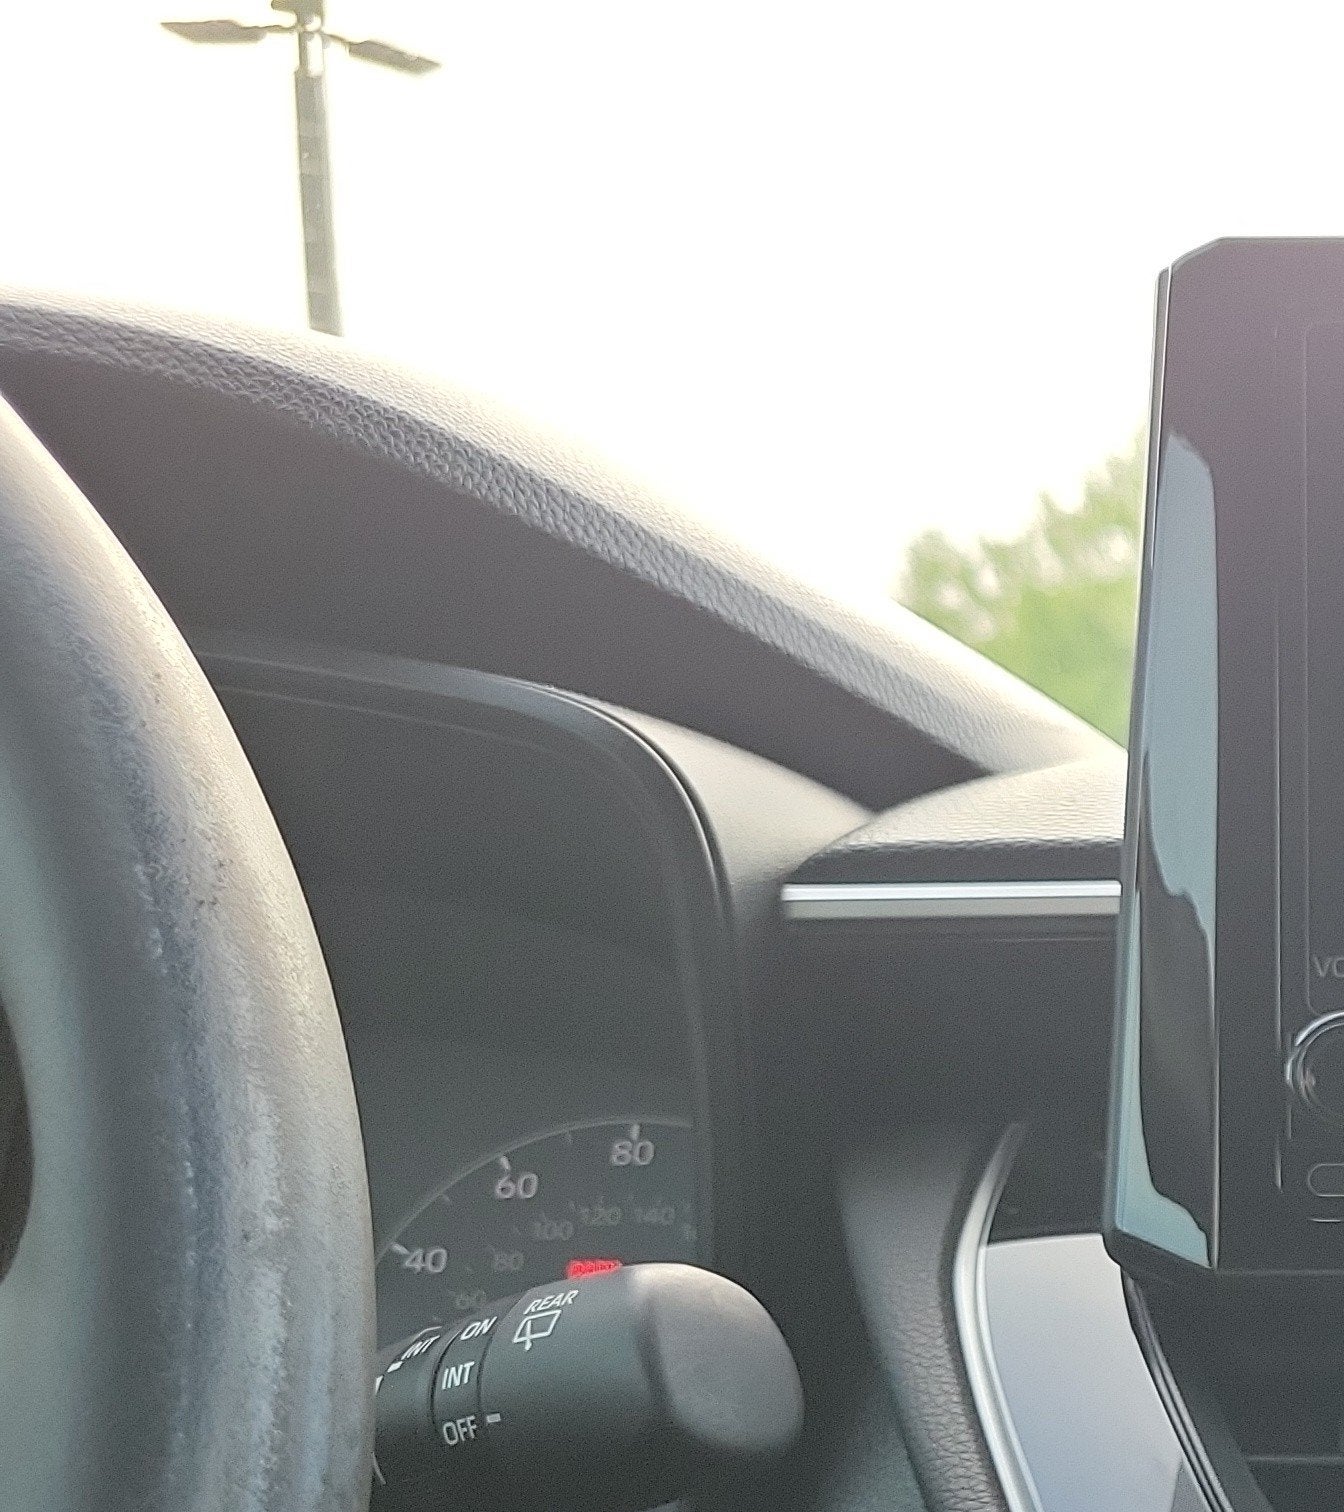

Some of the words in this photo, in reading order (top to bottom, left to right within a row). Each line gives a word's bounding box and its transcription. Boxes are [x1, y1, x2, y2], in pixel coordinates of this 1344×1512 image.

[609, 1139, 655, 1166] 80
[494, 1172, 539, 1200] 60
[403, 1246, 448, 1274] 40
[524, 1289, 578, 1315] REAR
[461, 1316, 498, 1342] ON
[401, 1335, 441, 1361] INT
[442, 1361, 475, 1391] INT
[443, 1415, 477, 1447] OFF
